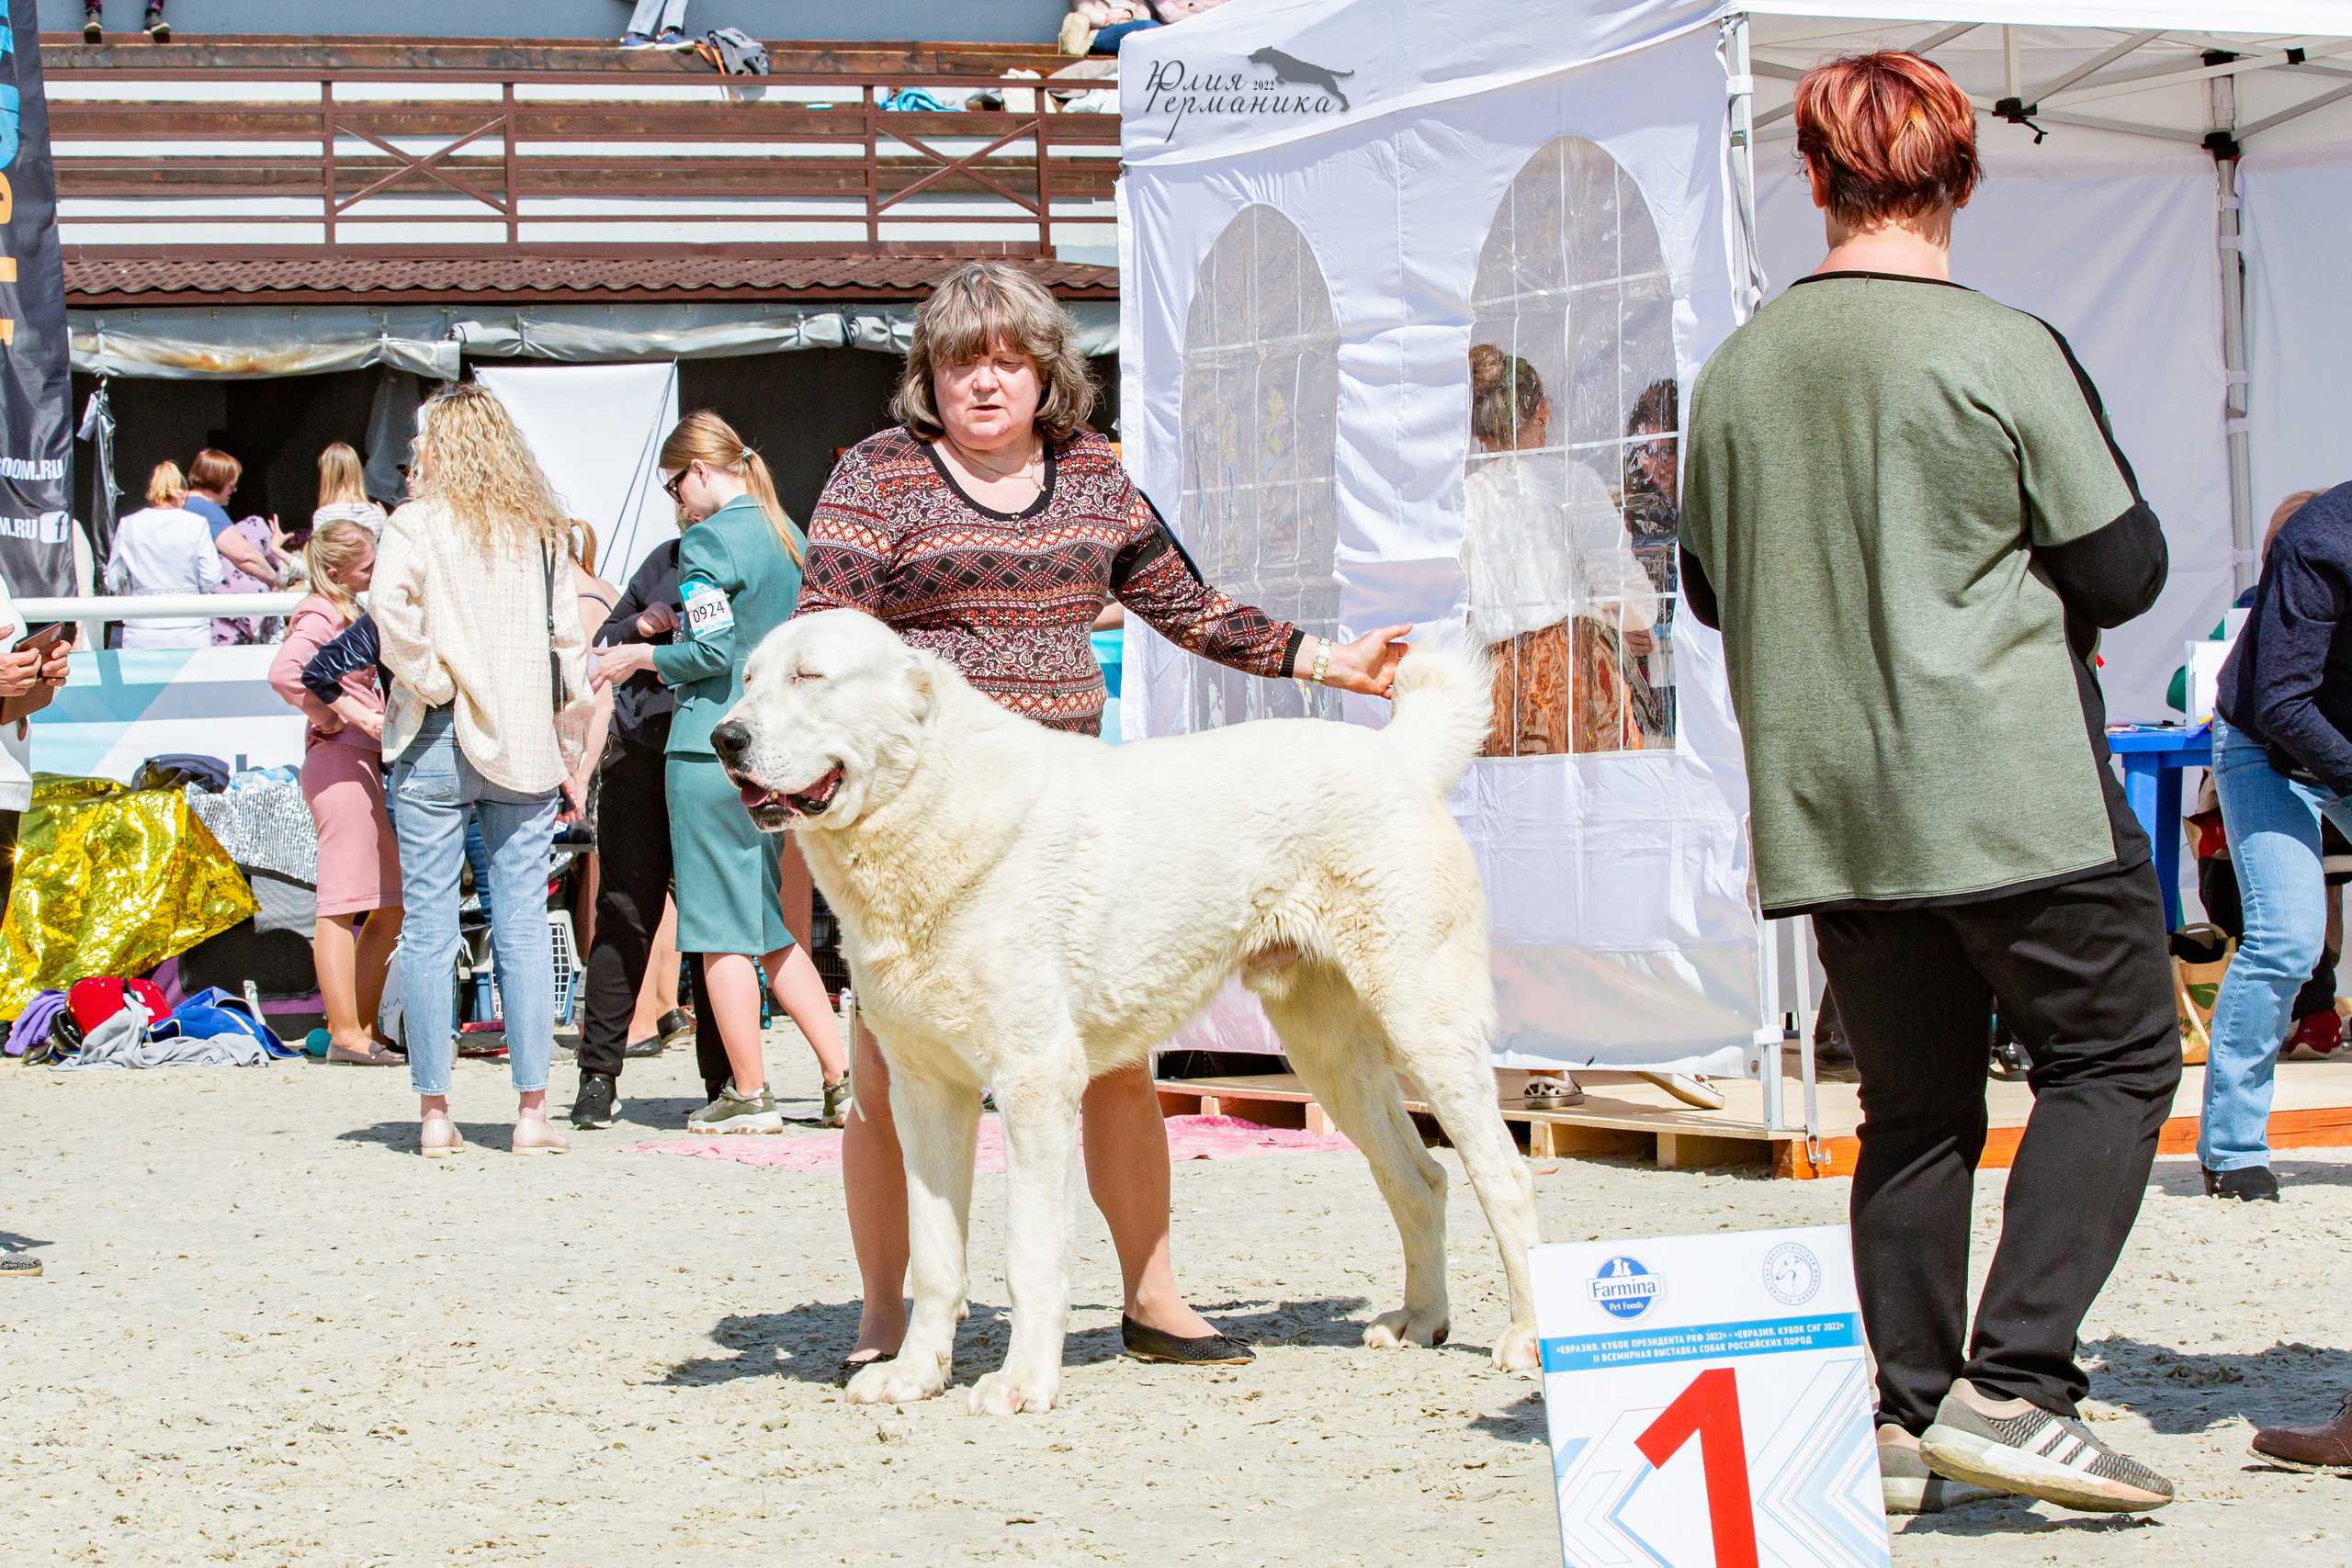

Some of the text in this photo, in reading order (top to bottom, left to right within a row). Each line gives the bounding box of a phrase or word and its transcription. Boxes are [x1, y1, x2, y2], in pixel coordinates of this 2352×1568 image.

[0, 457, 64, 480] OOM.RU
[693, 602, 725, 624] 0924
[1592, 1279, 1657, 1298] Farmina
[1610, 1301, 1644, 1311] Pet Foods
[1556, 1322, 1845, 1354] «ЕВРАЗИЯ. КУБОК ПРЕЗИДЕНТА РКФ 2022» «ЕВРАЗИЯ. КУБОК СНГ 2022»
[1601, 1349, 1652, 1362] ВСЕМИРНАЯ
[1654, 1346, 1698, 1358] ВЫСТАВКА
[1699, 1343, 1726, 1353] СОБАК
[1728, 1338, 1781, 1350] РОССИЙСКИХ
[1783, 1336, 1813, 1346] ПОРОД
[1634, 1367, 1759, 1568] 1
